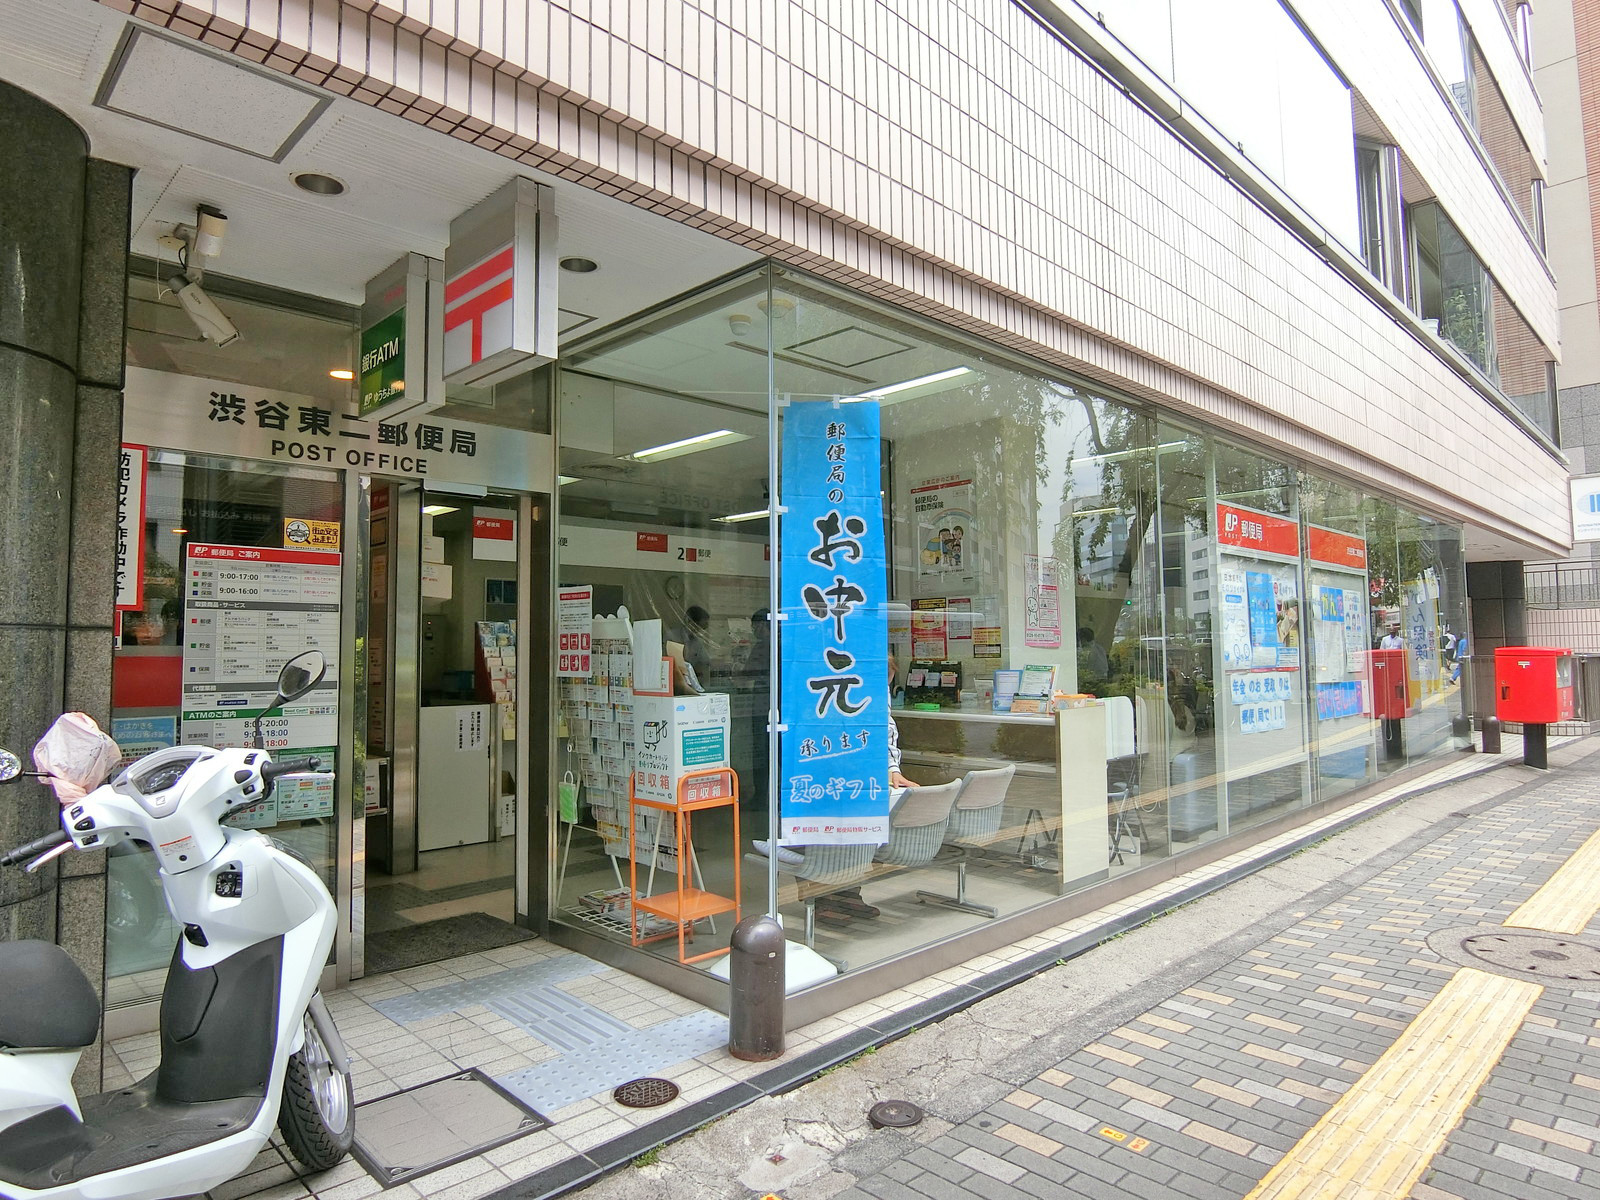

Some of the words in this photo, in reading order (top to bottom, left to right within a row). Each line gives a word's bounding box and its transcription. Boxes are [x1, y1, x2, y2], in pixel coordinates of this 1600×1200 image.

[361, 337, 399, 373] 銀行ATM
[208, 391, 478, 457] 渋谷東二郵便局
[271, 439, 337, 463] POST
[346, 449, 428, 474] OFFICE
[826, 422, 846, 504] 郵便局の
[1240, 520, 1263, 541] 郵便局
[210, 549, 235, 557] 郵便局
[238, 550, 261, 559] ご案内
[677, 547, 685, 561] 2
[219, 572, 259, 581] 9:00-17:00
[219, 587, 259, 595] 9:00-16:00
[801, 509, 872, 719] お中元
[1232, 678, 1290, 695] 年金のお受取りは
[188, 710, 237, 720] ATMのご案内
[799, 729, 871, 757] 承ります
[637, 771, 670, 791] 回収箱
[789, 774, 882, 803] 夏のギフト
[687, 785, 721, 801] 回収箱
